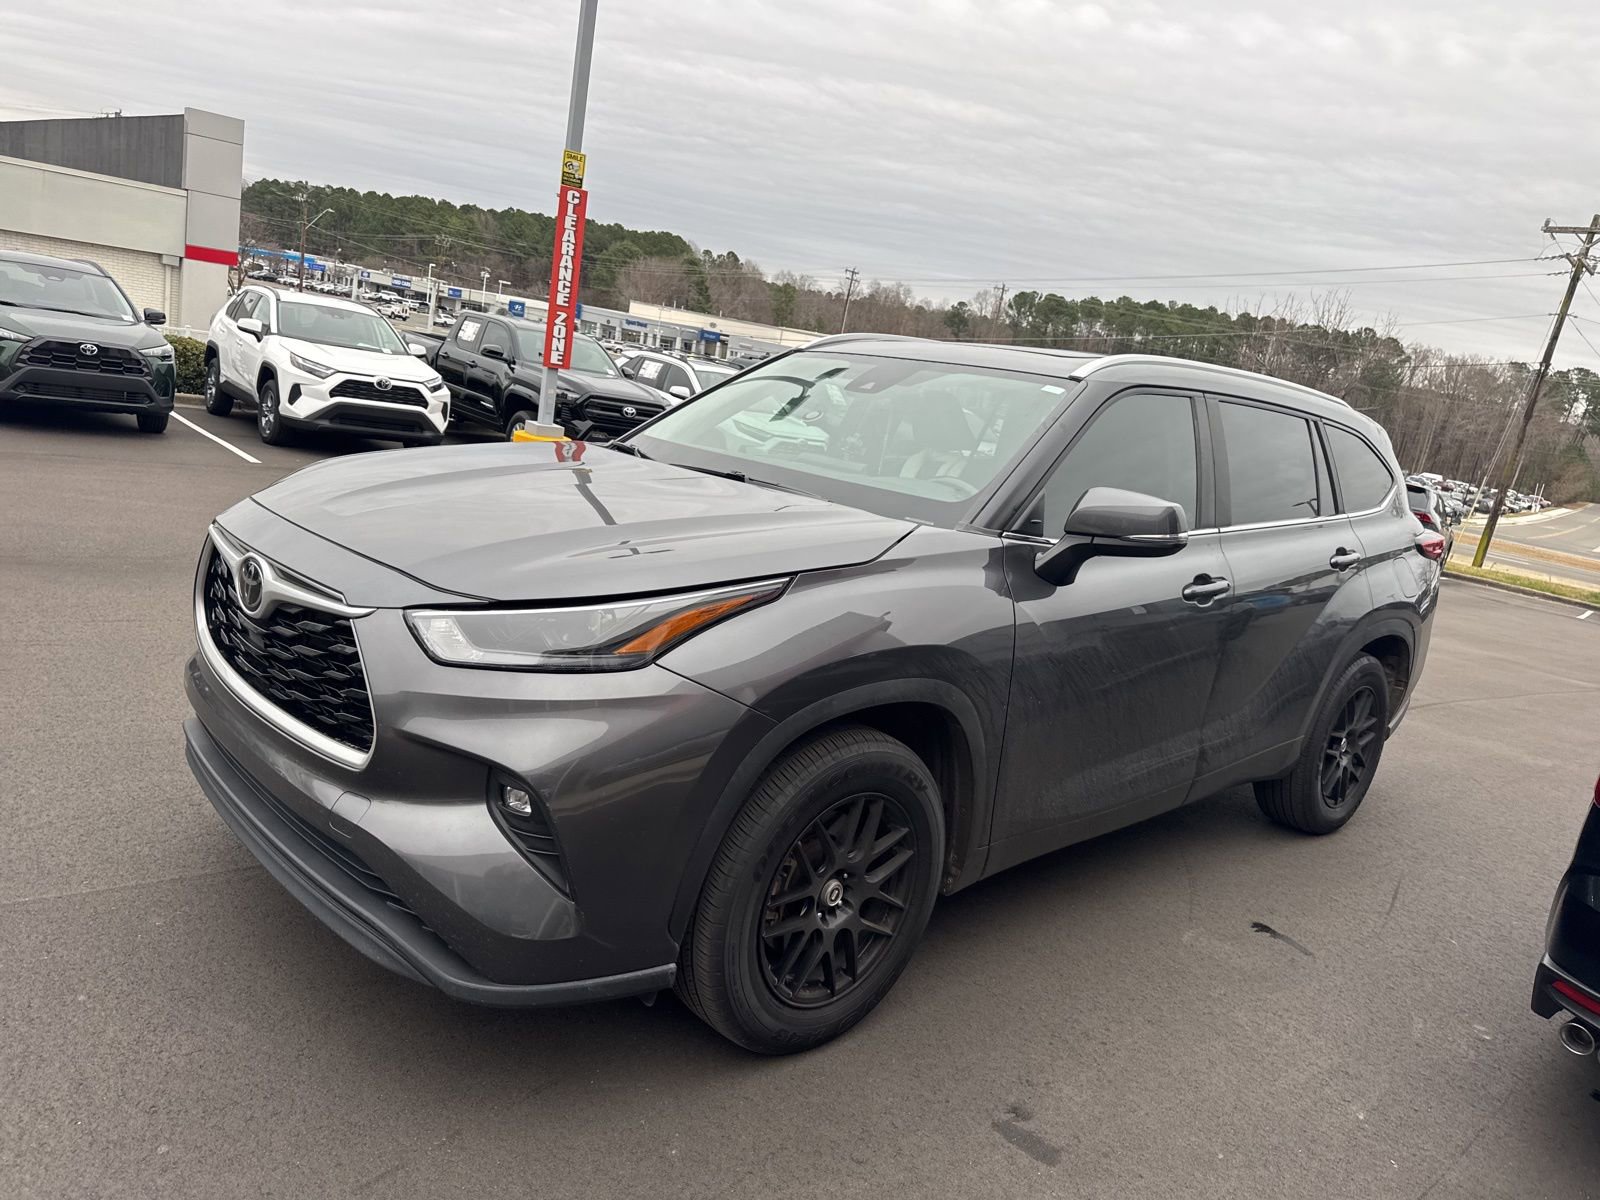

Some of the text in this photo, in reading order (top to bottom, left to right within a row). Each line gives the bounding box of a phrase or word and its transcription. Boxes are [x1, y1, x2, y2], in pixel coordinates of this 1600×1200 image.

[566, 152, 584, 163] SMILE
[556, 189, 580, 307] CLEARANCE
[550, 311, 568, 366] ZONE
